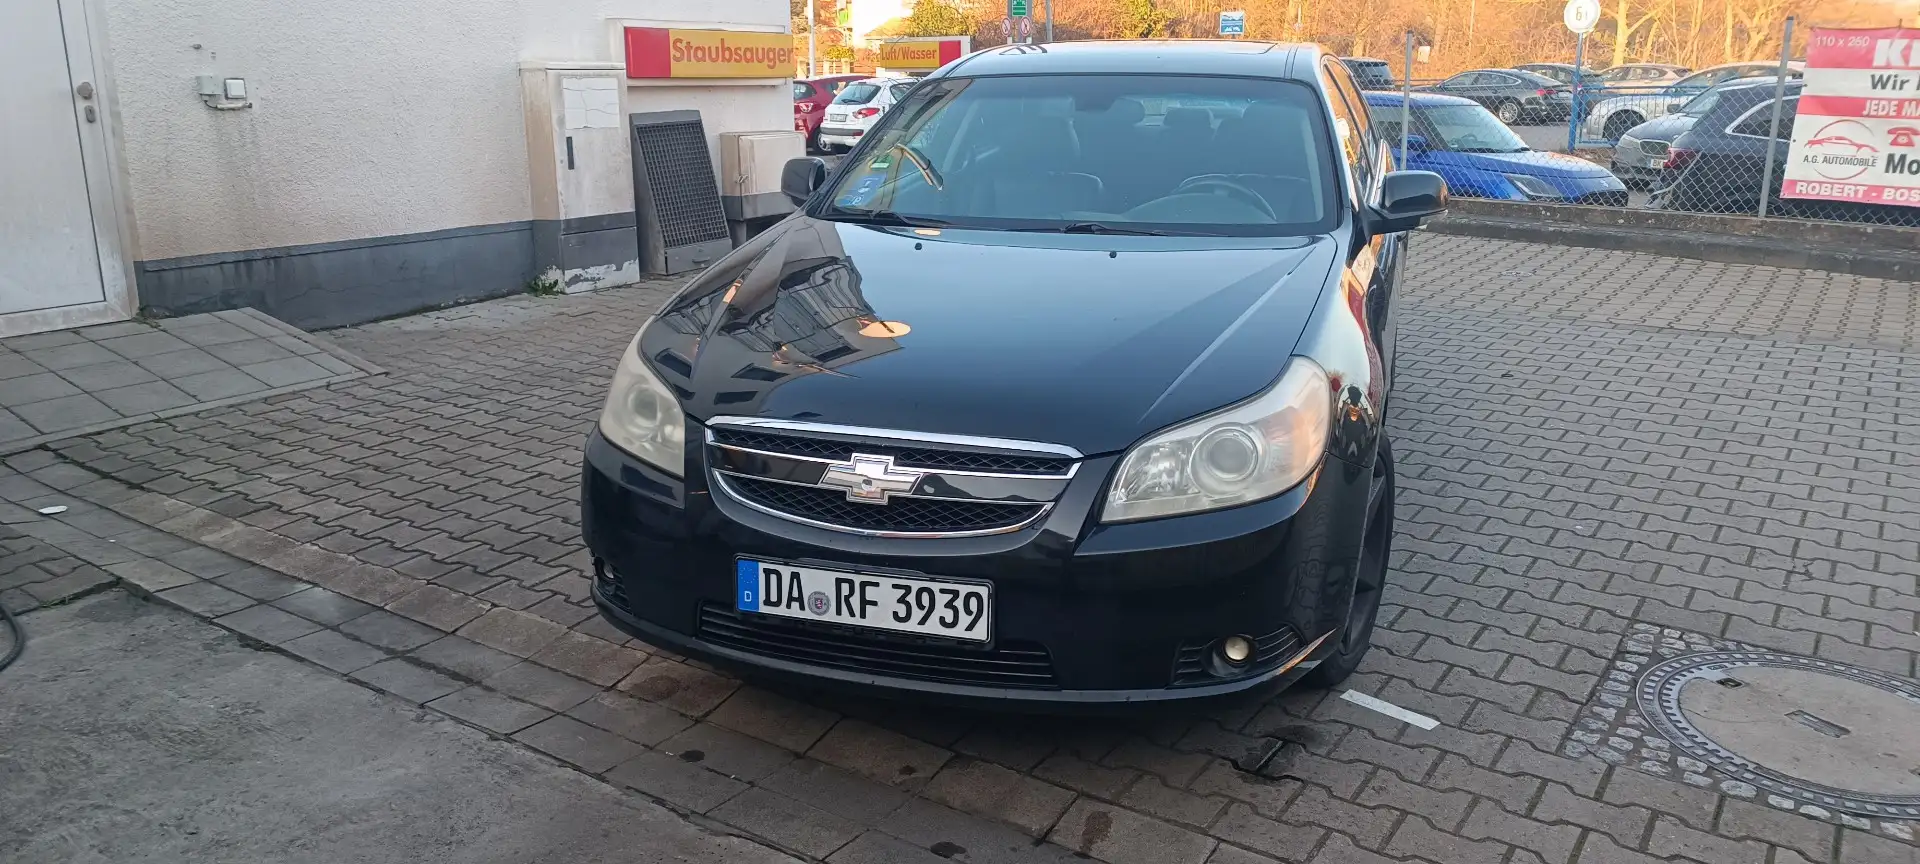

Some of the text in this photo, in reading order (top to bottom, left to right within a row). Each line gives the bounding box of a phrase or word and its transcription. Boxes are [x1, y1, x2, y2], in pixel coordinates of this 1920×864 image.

[672, 37, 795, 69] Staubsauger
[881, 45, 938, 61] Luft/Wasser
[1870, 73, 1911, 91] Wir
[1862, 99, 1899, 117] JEDE
[1802, 154, 1878, 168] A.G. AUTOMOBILE
[1795, 181, 1869, 199] ROBERT
[762, 567, 806, 612] DA
[834, 577, 880, 620] RF
[891, 583, 985, 632] 3939
